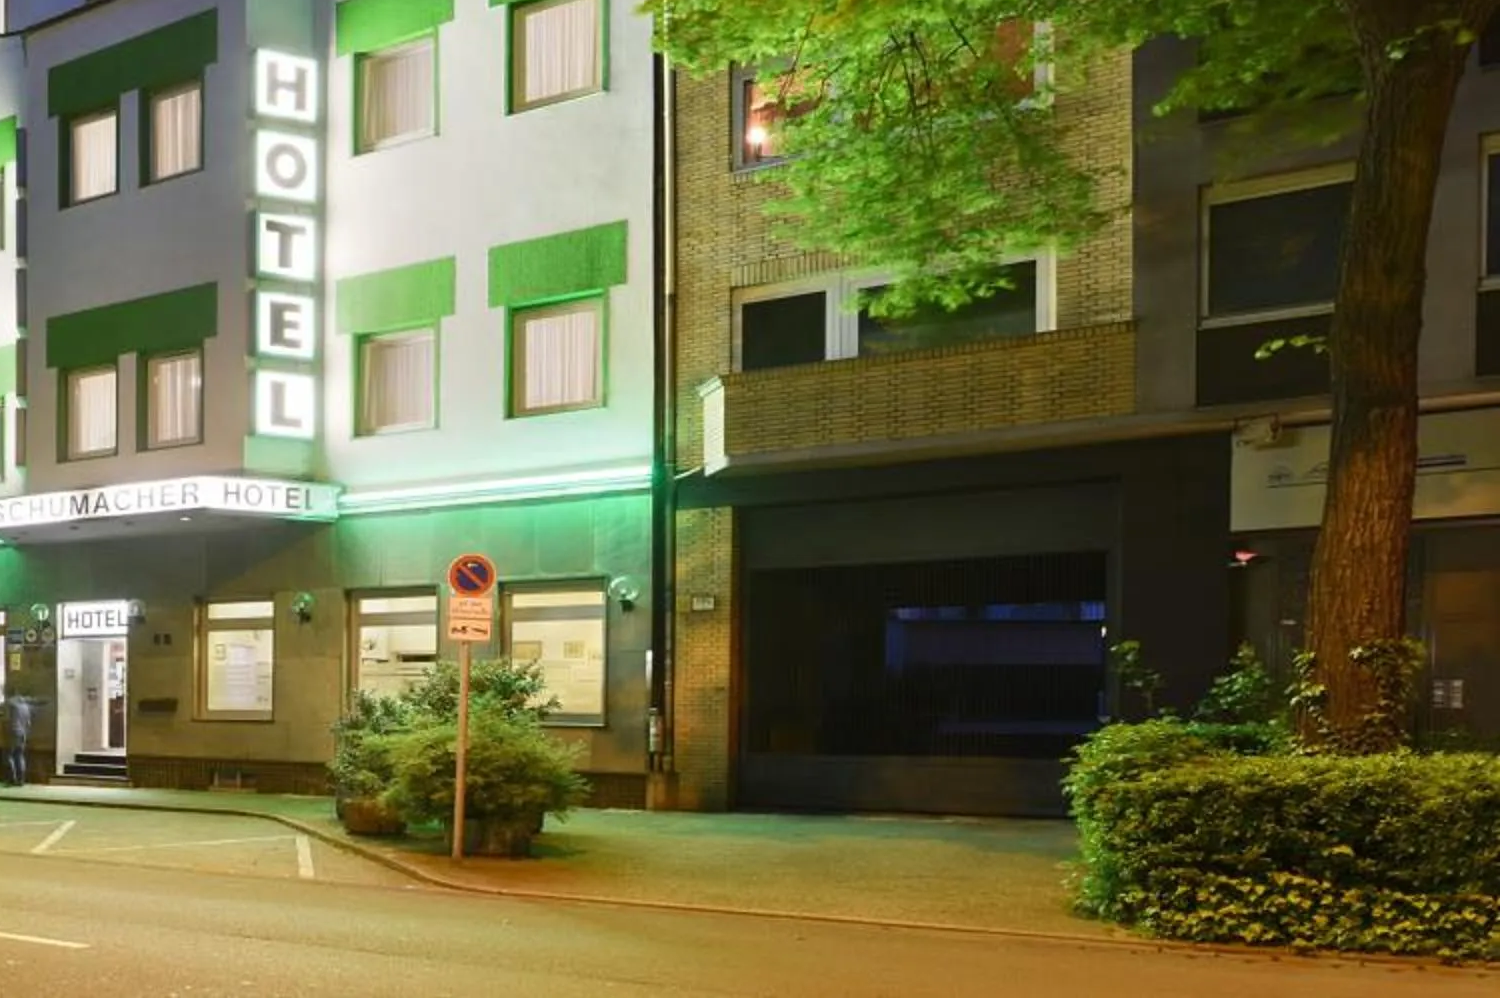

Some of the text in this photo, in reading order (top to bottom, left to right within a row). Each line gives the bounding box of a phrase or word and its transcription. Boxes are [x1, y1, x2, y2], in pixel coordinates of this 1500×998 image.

[265, 60, 308, 429] HOTEL
[223, 482, 314, 511] HOTEL
[67, 609, 129, 629] HOTEL
